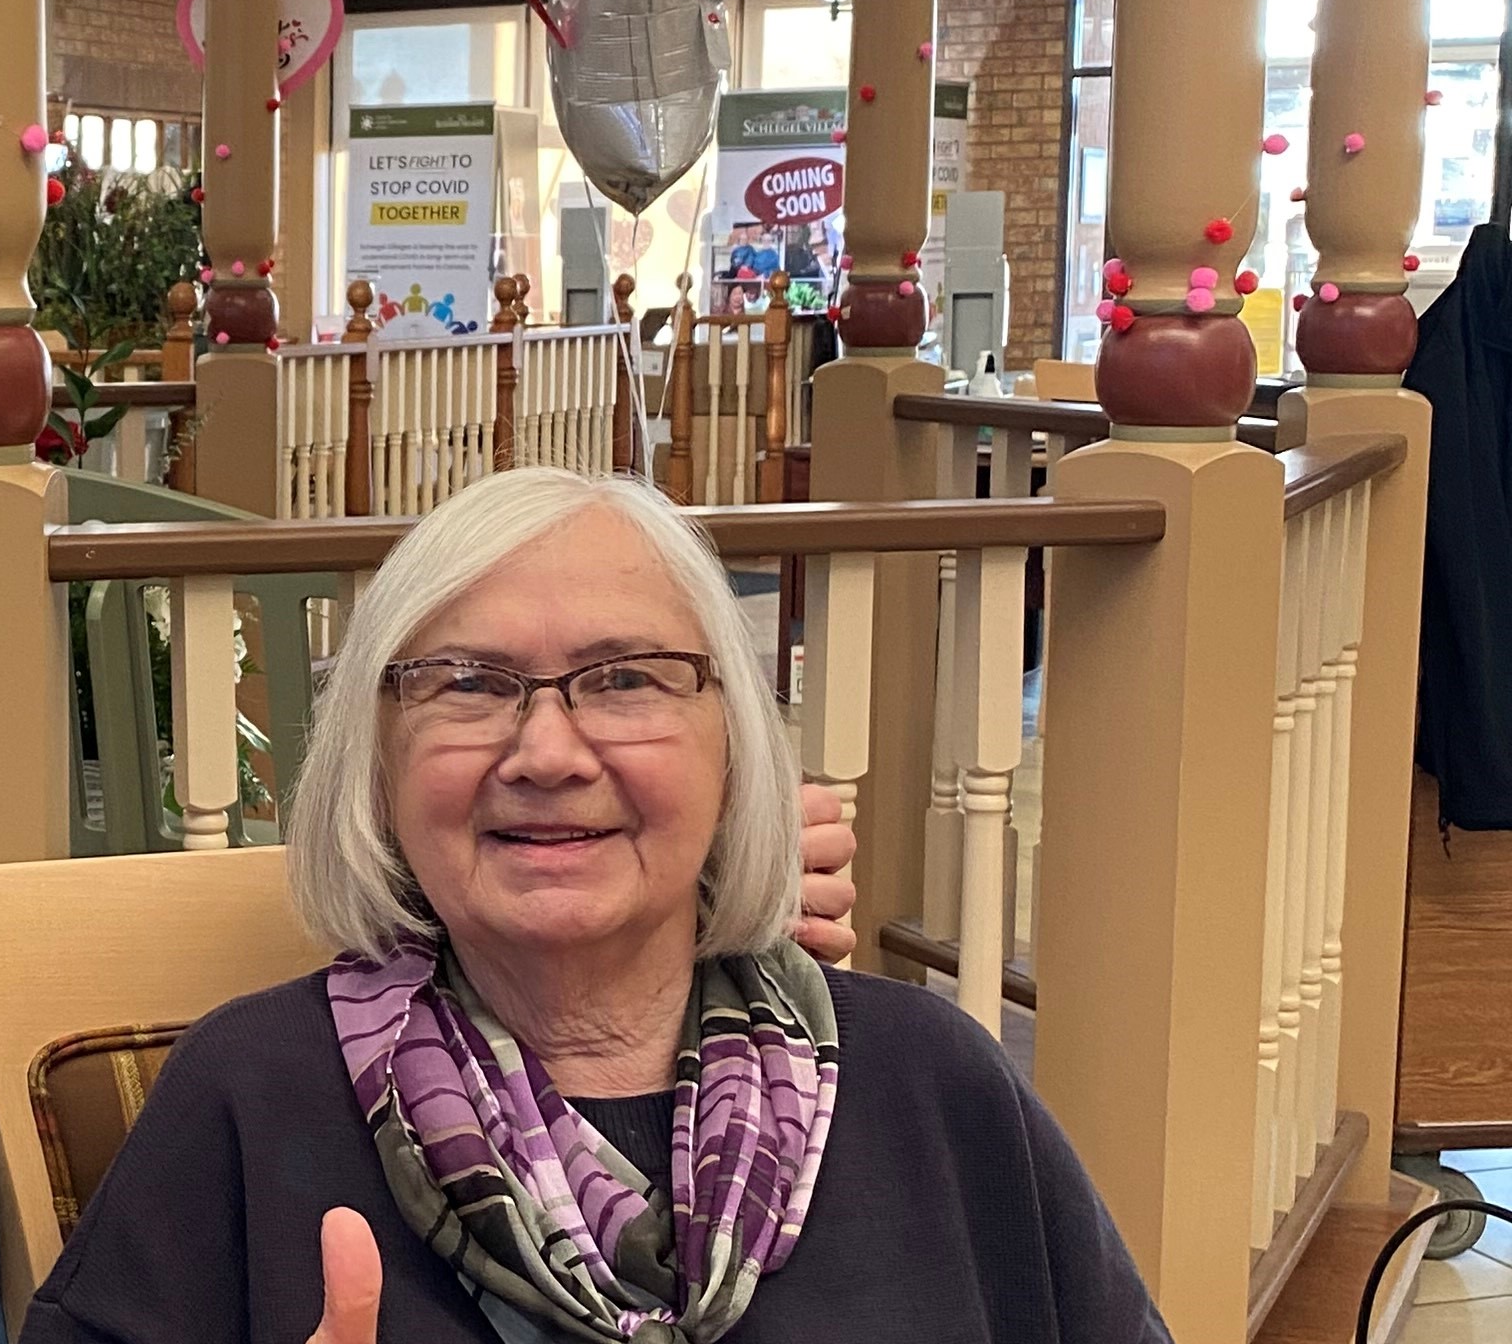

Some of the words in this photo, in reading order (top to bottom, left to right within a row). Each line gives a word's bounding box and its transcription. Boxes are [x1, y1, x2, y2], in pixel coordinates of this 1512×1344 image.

[369, 155, 408, 170] LET'S
[408, 155, 448, 169] FIGHT
[449, 154, 472, 169] TO
[370, 181, 411, 195] STOP
[415, 180, 469, 195] COVID
[762, 164, 835, 196] COMING
[775, 191, 826, 219] SOON
[378, 206, 460, 221] TOGETHER
